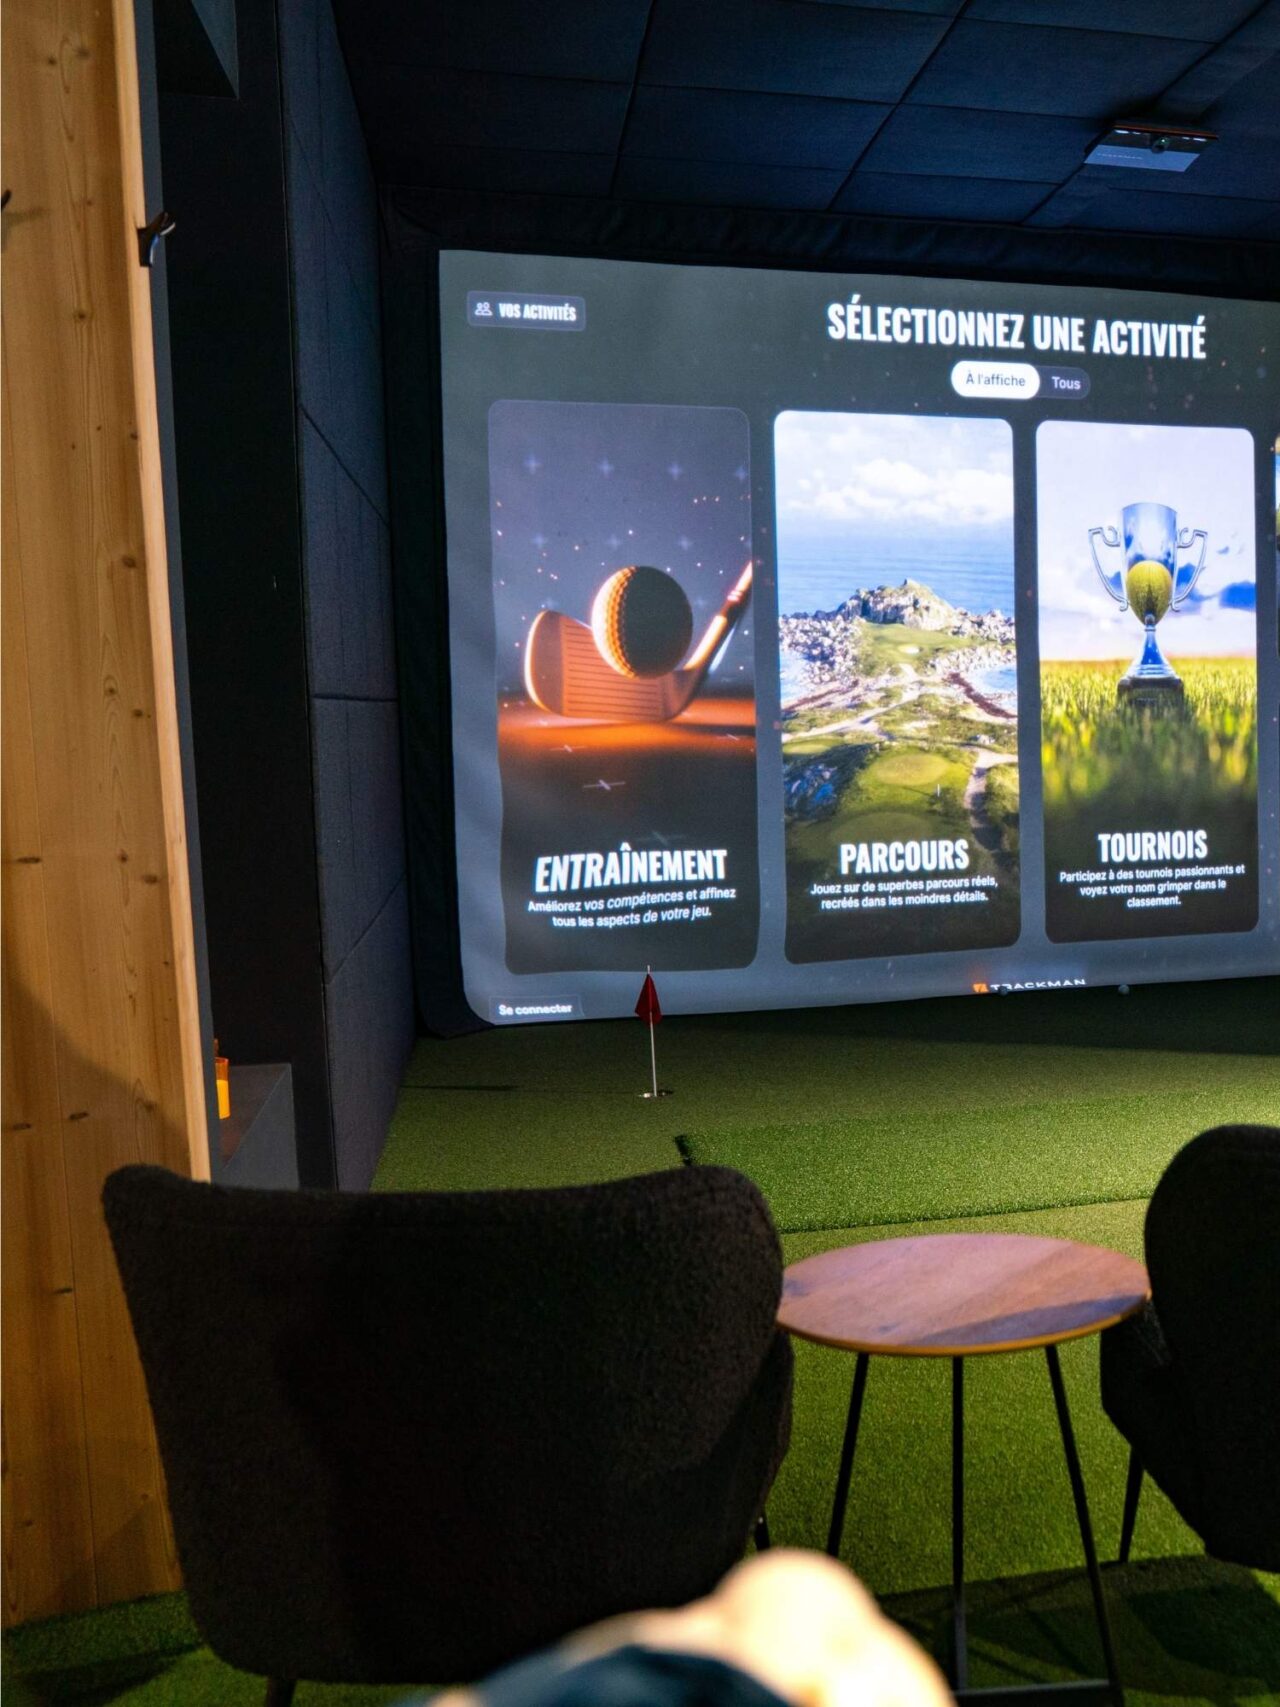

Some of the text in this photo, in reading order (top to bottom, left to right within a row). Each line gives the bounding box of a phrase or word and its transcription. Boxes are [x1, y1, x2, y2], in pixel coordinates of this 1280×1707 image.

[498, 303, 577, 321] VOS ACTIVITÉS
[827, 294, 1207, 359] SÉLECTIONNEZ UNE ACTIVITÉ
[965, 372, 1026, 387] À l'affiche
[1052, 376, 1081, 390] Tous
[1098, 829, 1208, 863] TOURNOIS
[840, 838, 970, 875] PARCOURS
[535, 841, 728, 893] ENTRAÎNEMENT
[1059, 864, 1245, 883] Participez à des tournois passionnants et
[810, 875, 998, 895] Jouez sur de superbes parcours réels,
[1080, 878, 1227, 897] voyez votre nom grimper dans le
[528, 887, 737, 912] Améliorez vos compétences et affinez
[821, 890, 989, 909] recréés dans les moindres détails.
[1127, 896, 1181, 908] classement.
[552, 904, 712, 929] tous les aspects de votre jeu.
[498, 1004, 573, 1016] Se connecter
